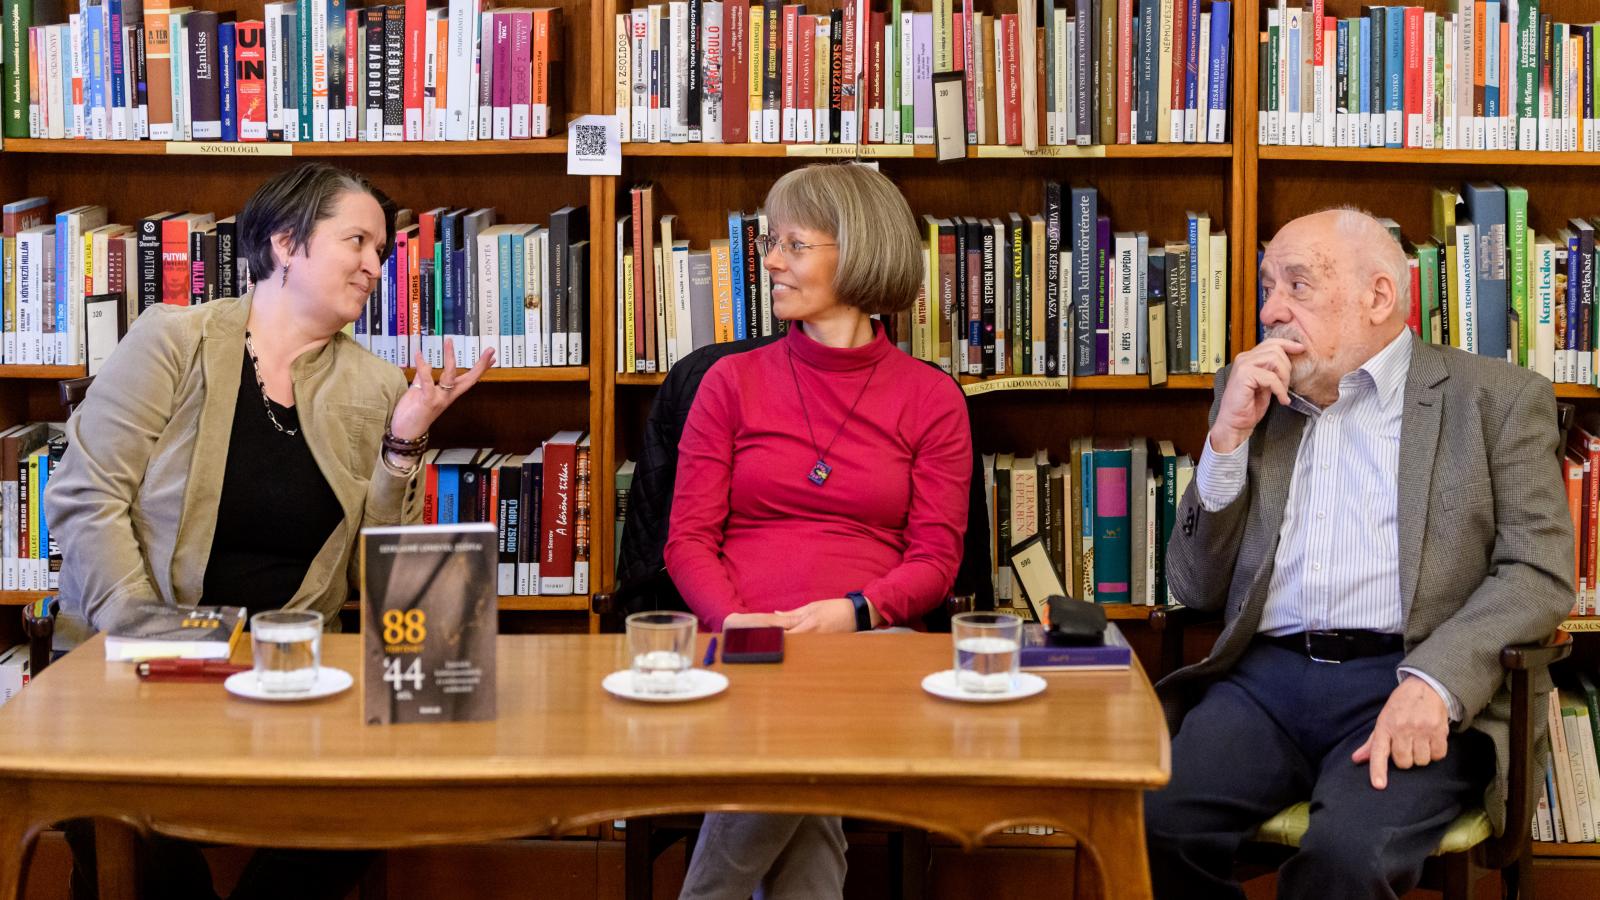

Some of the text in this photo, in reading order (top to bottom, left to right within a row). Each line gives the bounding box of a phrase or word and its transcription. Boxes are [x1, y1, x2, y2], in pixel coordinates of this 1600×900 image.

[196, 31, 207, 80] Hankiss
[369, 44, 384, 98] HÁBORÚ
[618, 33, 627, 77] ZSOLDOS
[200, 144, 259, 153] SZOCIOLÓGIA
[1048, 211, 1060, 251] VILÁGŰR
[20, 240, 29, 265] HULLÁM
[144, 250, 156, 280] PATTON
[163, 252, 188, 261] PUTYIN
[222, 234, 231, 286] SOHA NEM
[983, 235, 994, 304] STEPHEN HAWKING
[1012, 227, 1022, 278] CSALÁDFA
[1048, 253, 1060, 280] KÉPES
[1077, 195, 1090, 344] A fizika kultúrtörténete
[1462, 233, 1472, 309] TECHNIKATÖRTÉNETE
[20, 265, 30, 299] KÖVETKEZŐ
[144, 282, 157, 292] ÉS
[192, 260, 205, 295] PUTYIN
[750, 273, 755, 283] AZ
[1170, 267, 1178, 298] KÉMIA
[1048, 281, 1059, 319] ATLASZA
[1120, 249, 1131, 351] KÉPES ENCIKLOPÉDIA
[556, 462, 569, 536] A bőrönd titkai
[506, 499, 518, 553] OROSZ NAPLÓ
[383, 608, 427, 645] 88
